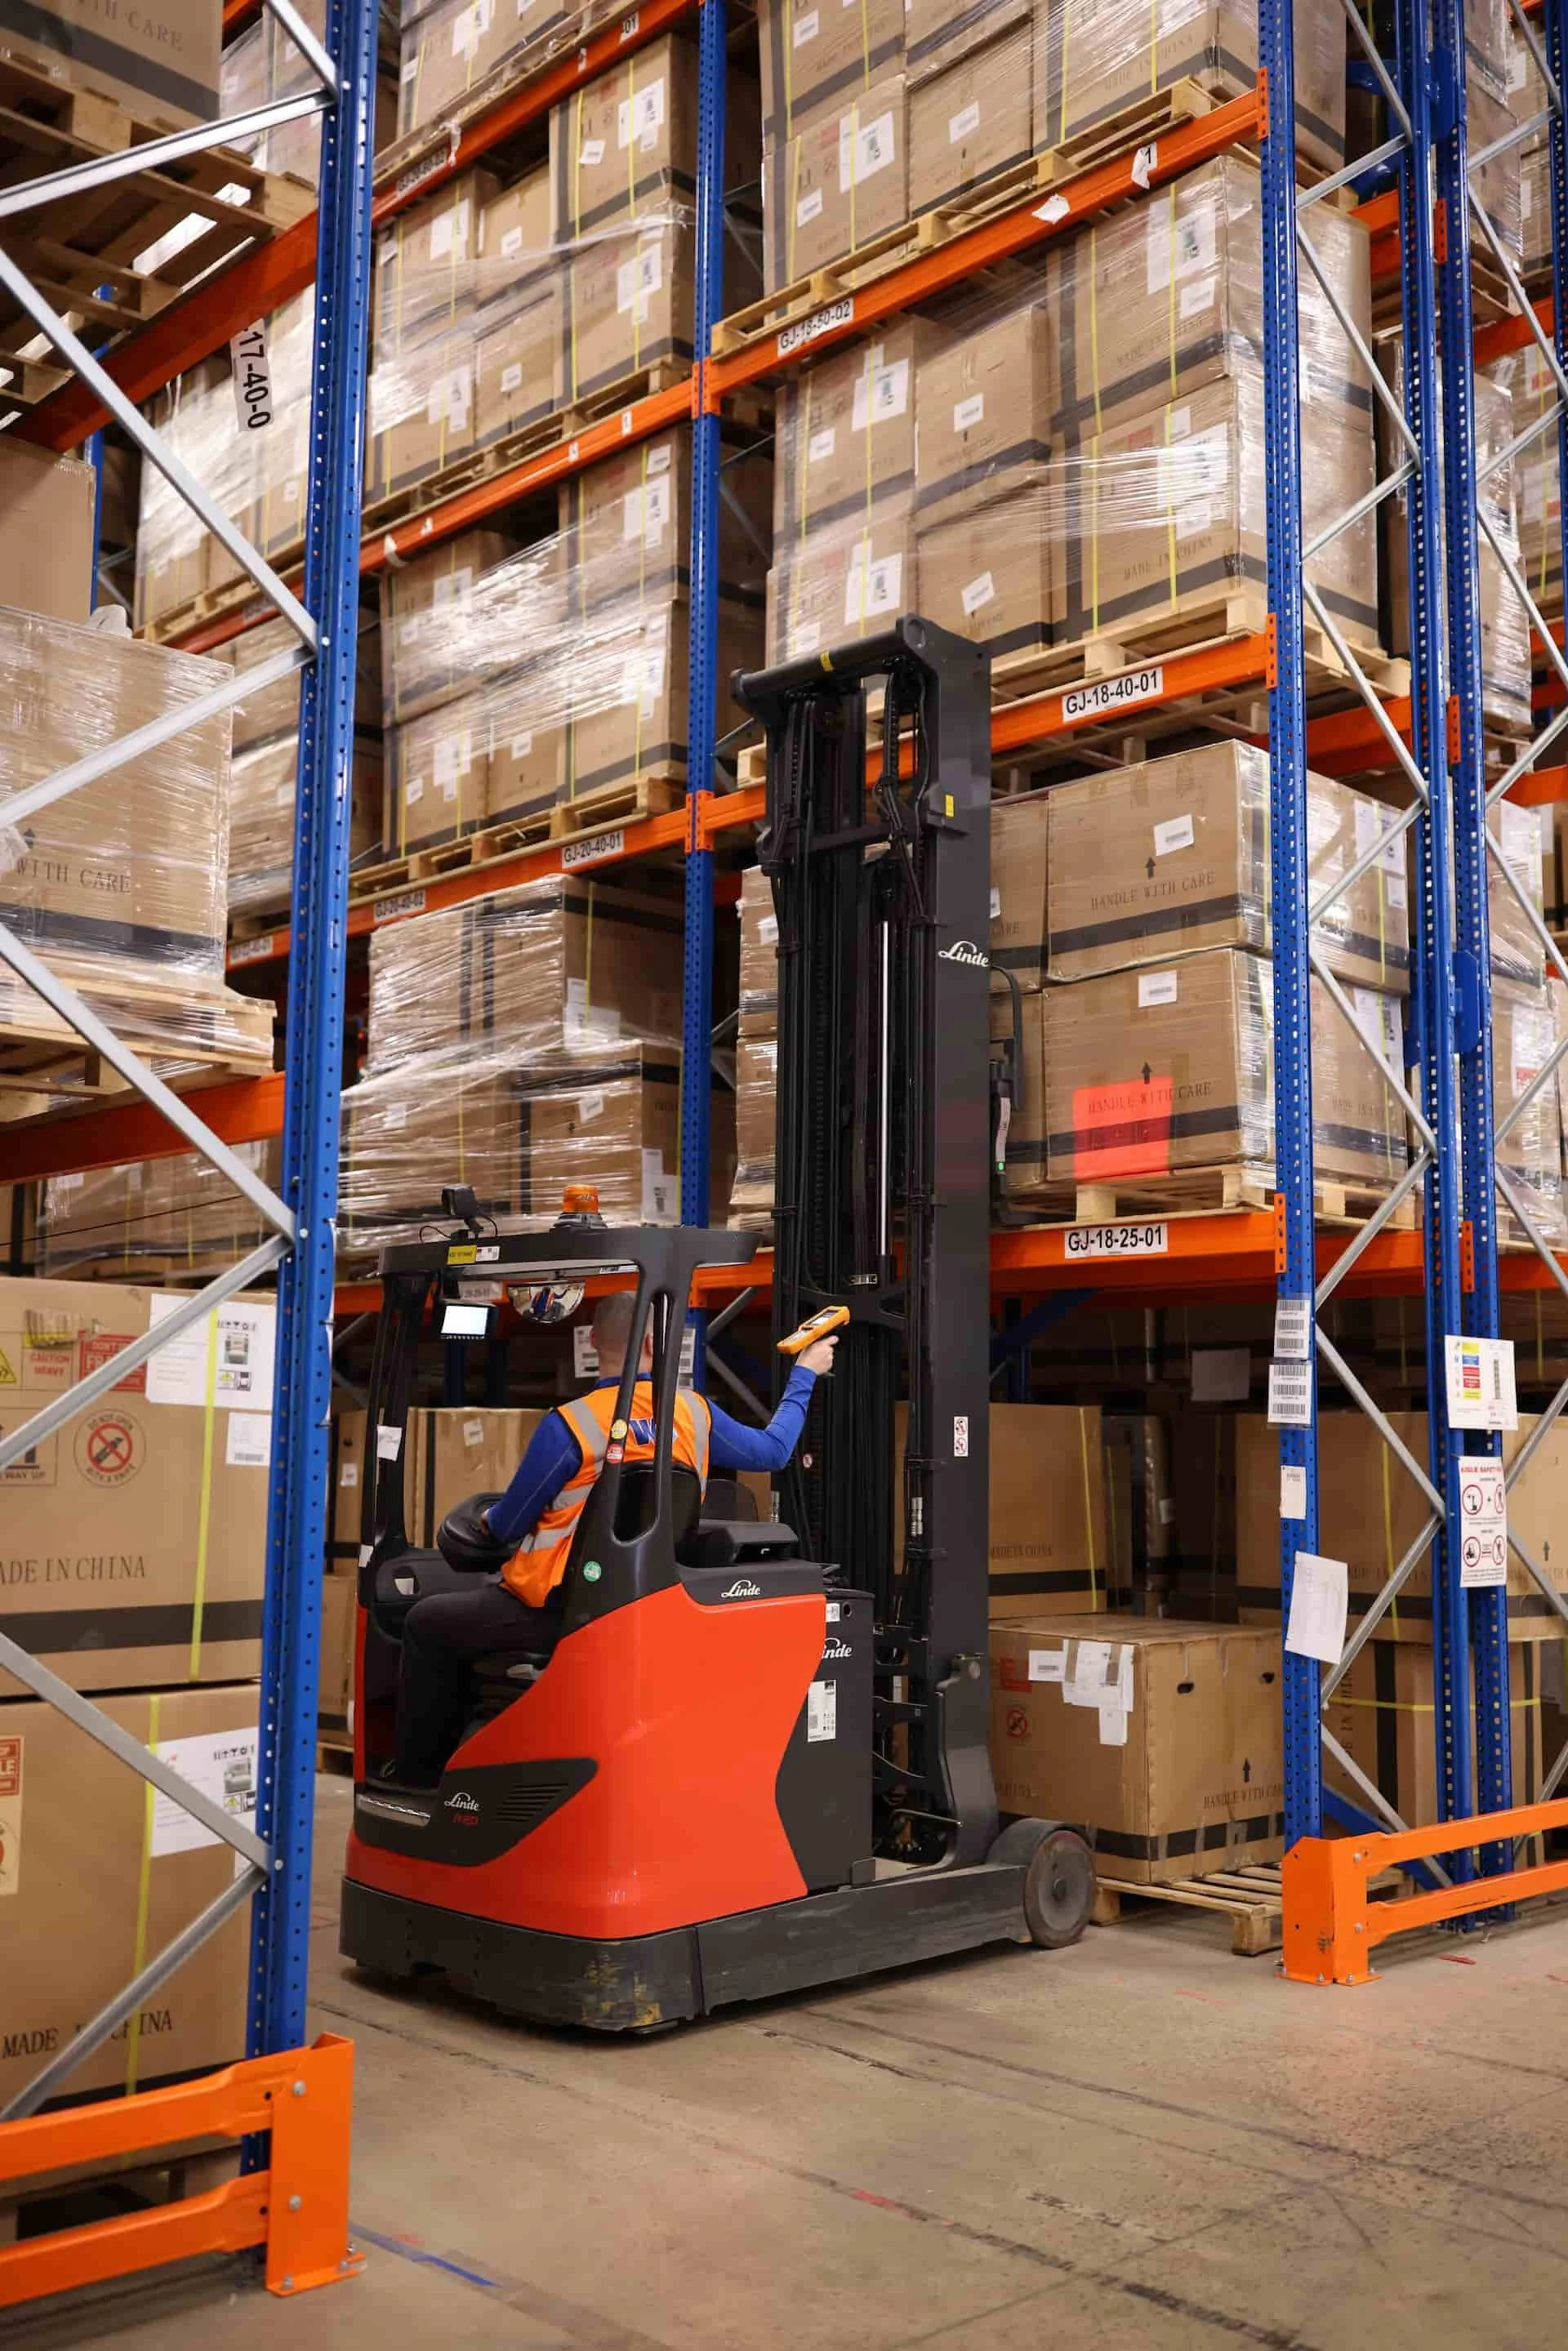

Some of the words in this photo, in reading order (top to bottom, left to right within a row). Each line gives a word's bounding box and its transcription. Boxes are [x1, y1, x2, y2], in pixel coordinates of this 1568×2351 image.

[1066, 670, 1157, 714] GJ-18-40-01
[564, 832, 621, 862] GJ-20-40-01
[16, 857, 68, 883] WITH
[79, 868, 131, 895] CARE
[1090, 888, 1138, 911] HANDLE
[1144, 881, 1176, 898] WITH
[1182, 870, 1216, 892] CARE
[938, 940, 990, 967] Linde
[1178, 1081, 1212, 1100] CARE
[1067, 1225, 1162, 1252] GJ-18-25-01
[30, 1352, 70, 1364] CAUTION
[34, 1366, 65, 1377] HEAVY
[7, 1471, 29, 1479] WAY
[32, 1471, 47, 1479] UP
[0, 1560, 39, 1586] ADE
[46, 1557, 71, 1583] IN
[76, 1555, 146, 1581] CHINA
[720, 1579, 761, 1598] Linde
[443, 1792, 482, 1811] Linde
[2, 2028, 60, 2059] MADE
